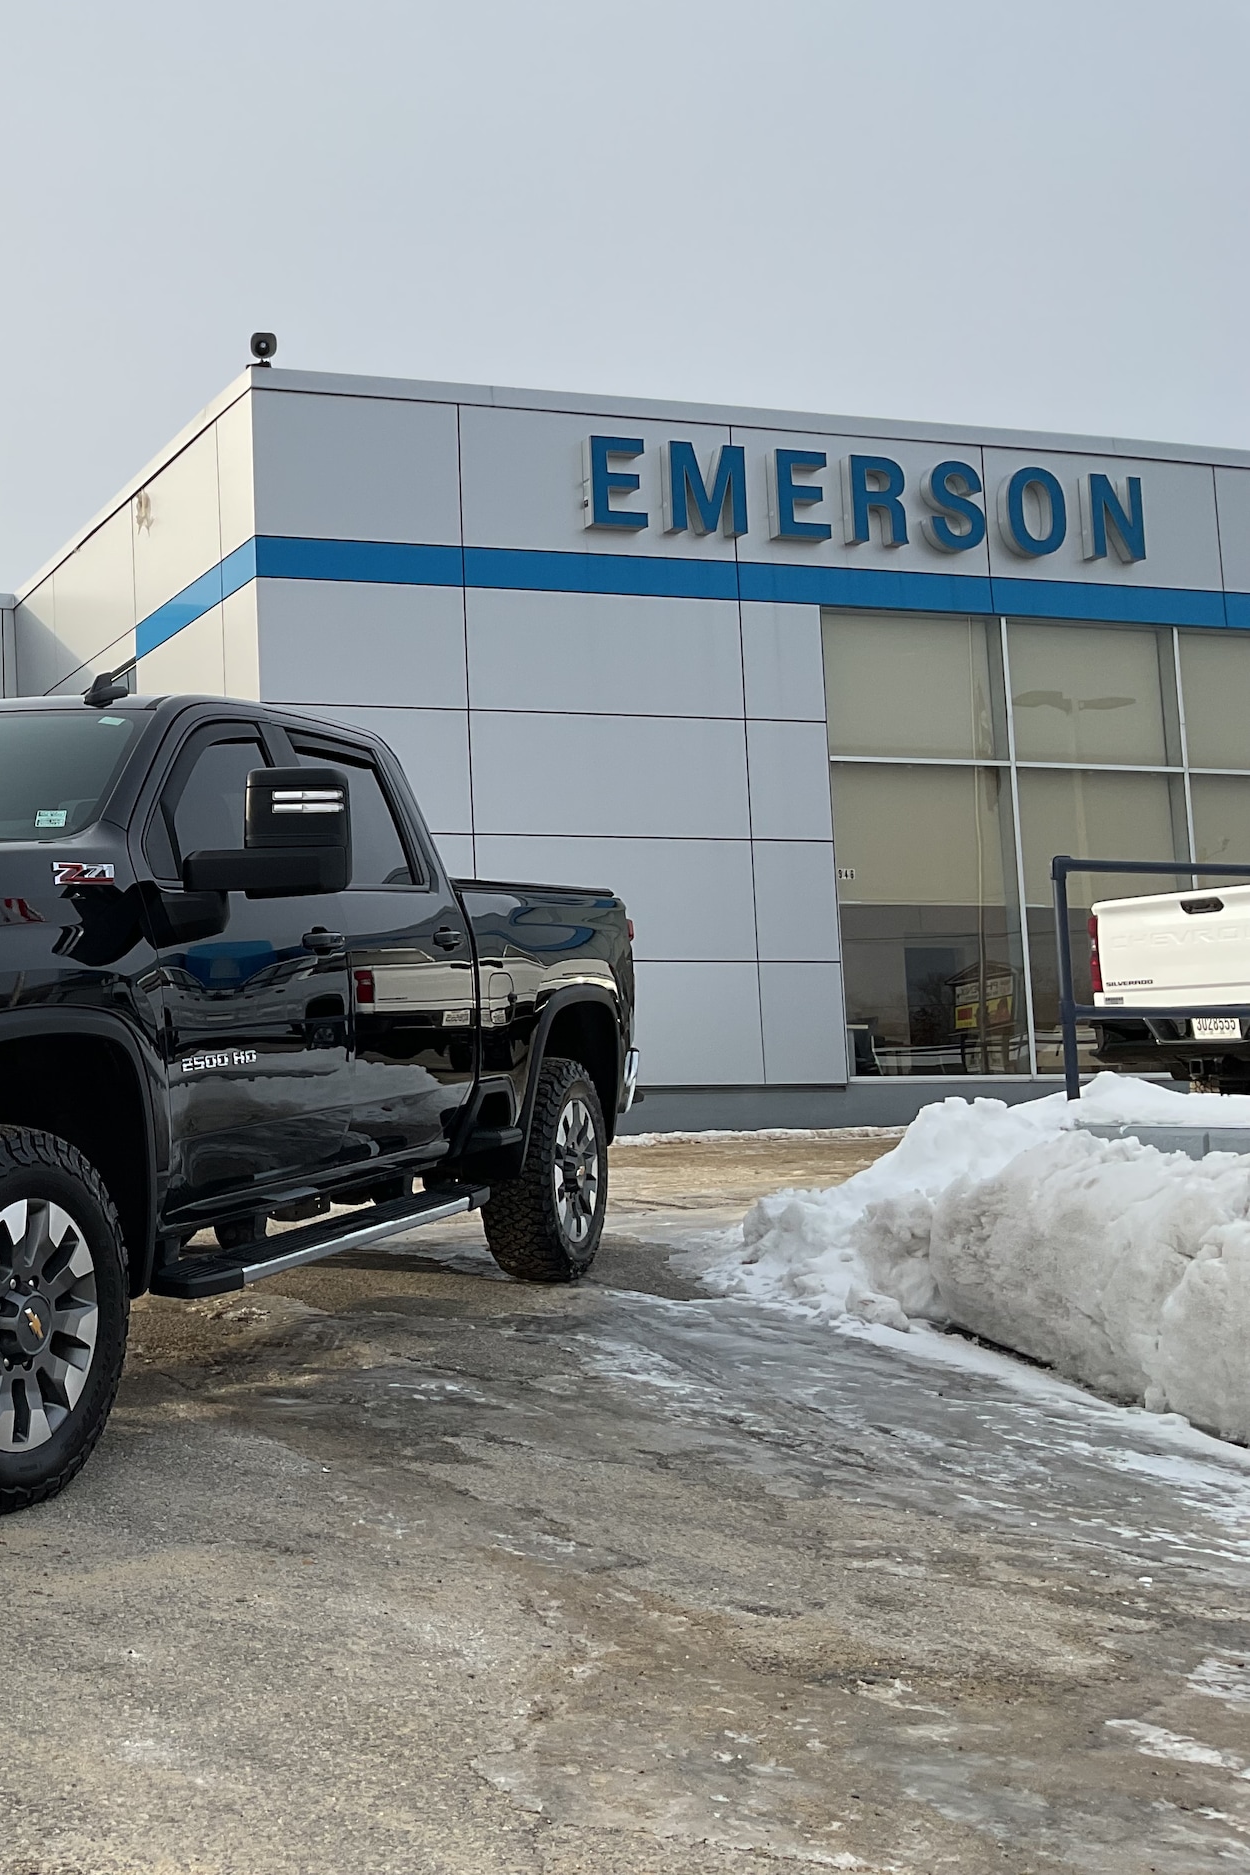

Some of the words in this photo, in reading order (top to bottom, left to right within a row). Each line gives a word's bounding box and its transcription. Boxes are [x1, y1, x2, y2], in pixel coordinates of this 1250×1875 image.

[585, 434, 1146, 563] EMERSON
[53, 861, 115, 885] Z71
[1110, 925, 1250, 951] CHEVRO
[1105, 979, 1153, 987] SILVERADO
[181, 1053, 229, 1073] 2500
[233, 1049, 257, 1065] HD
